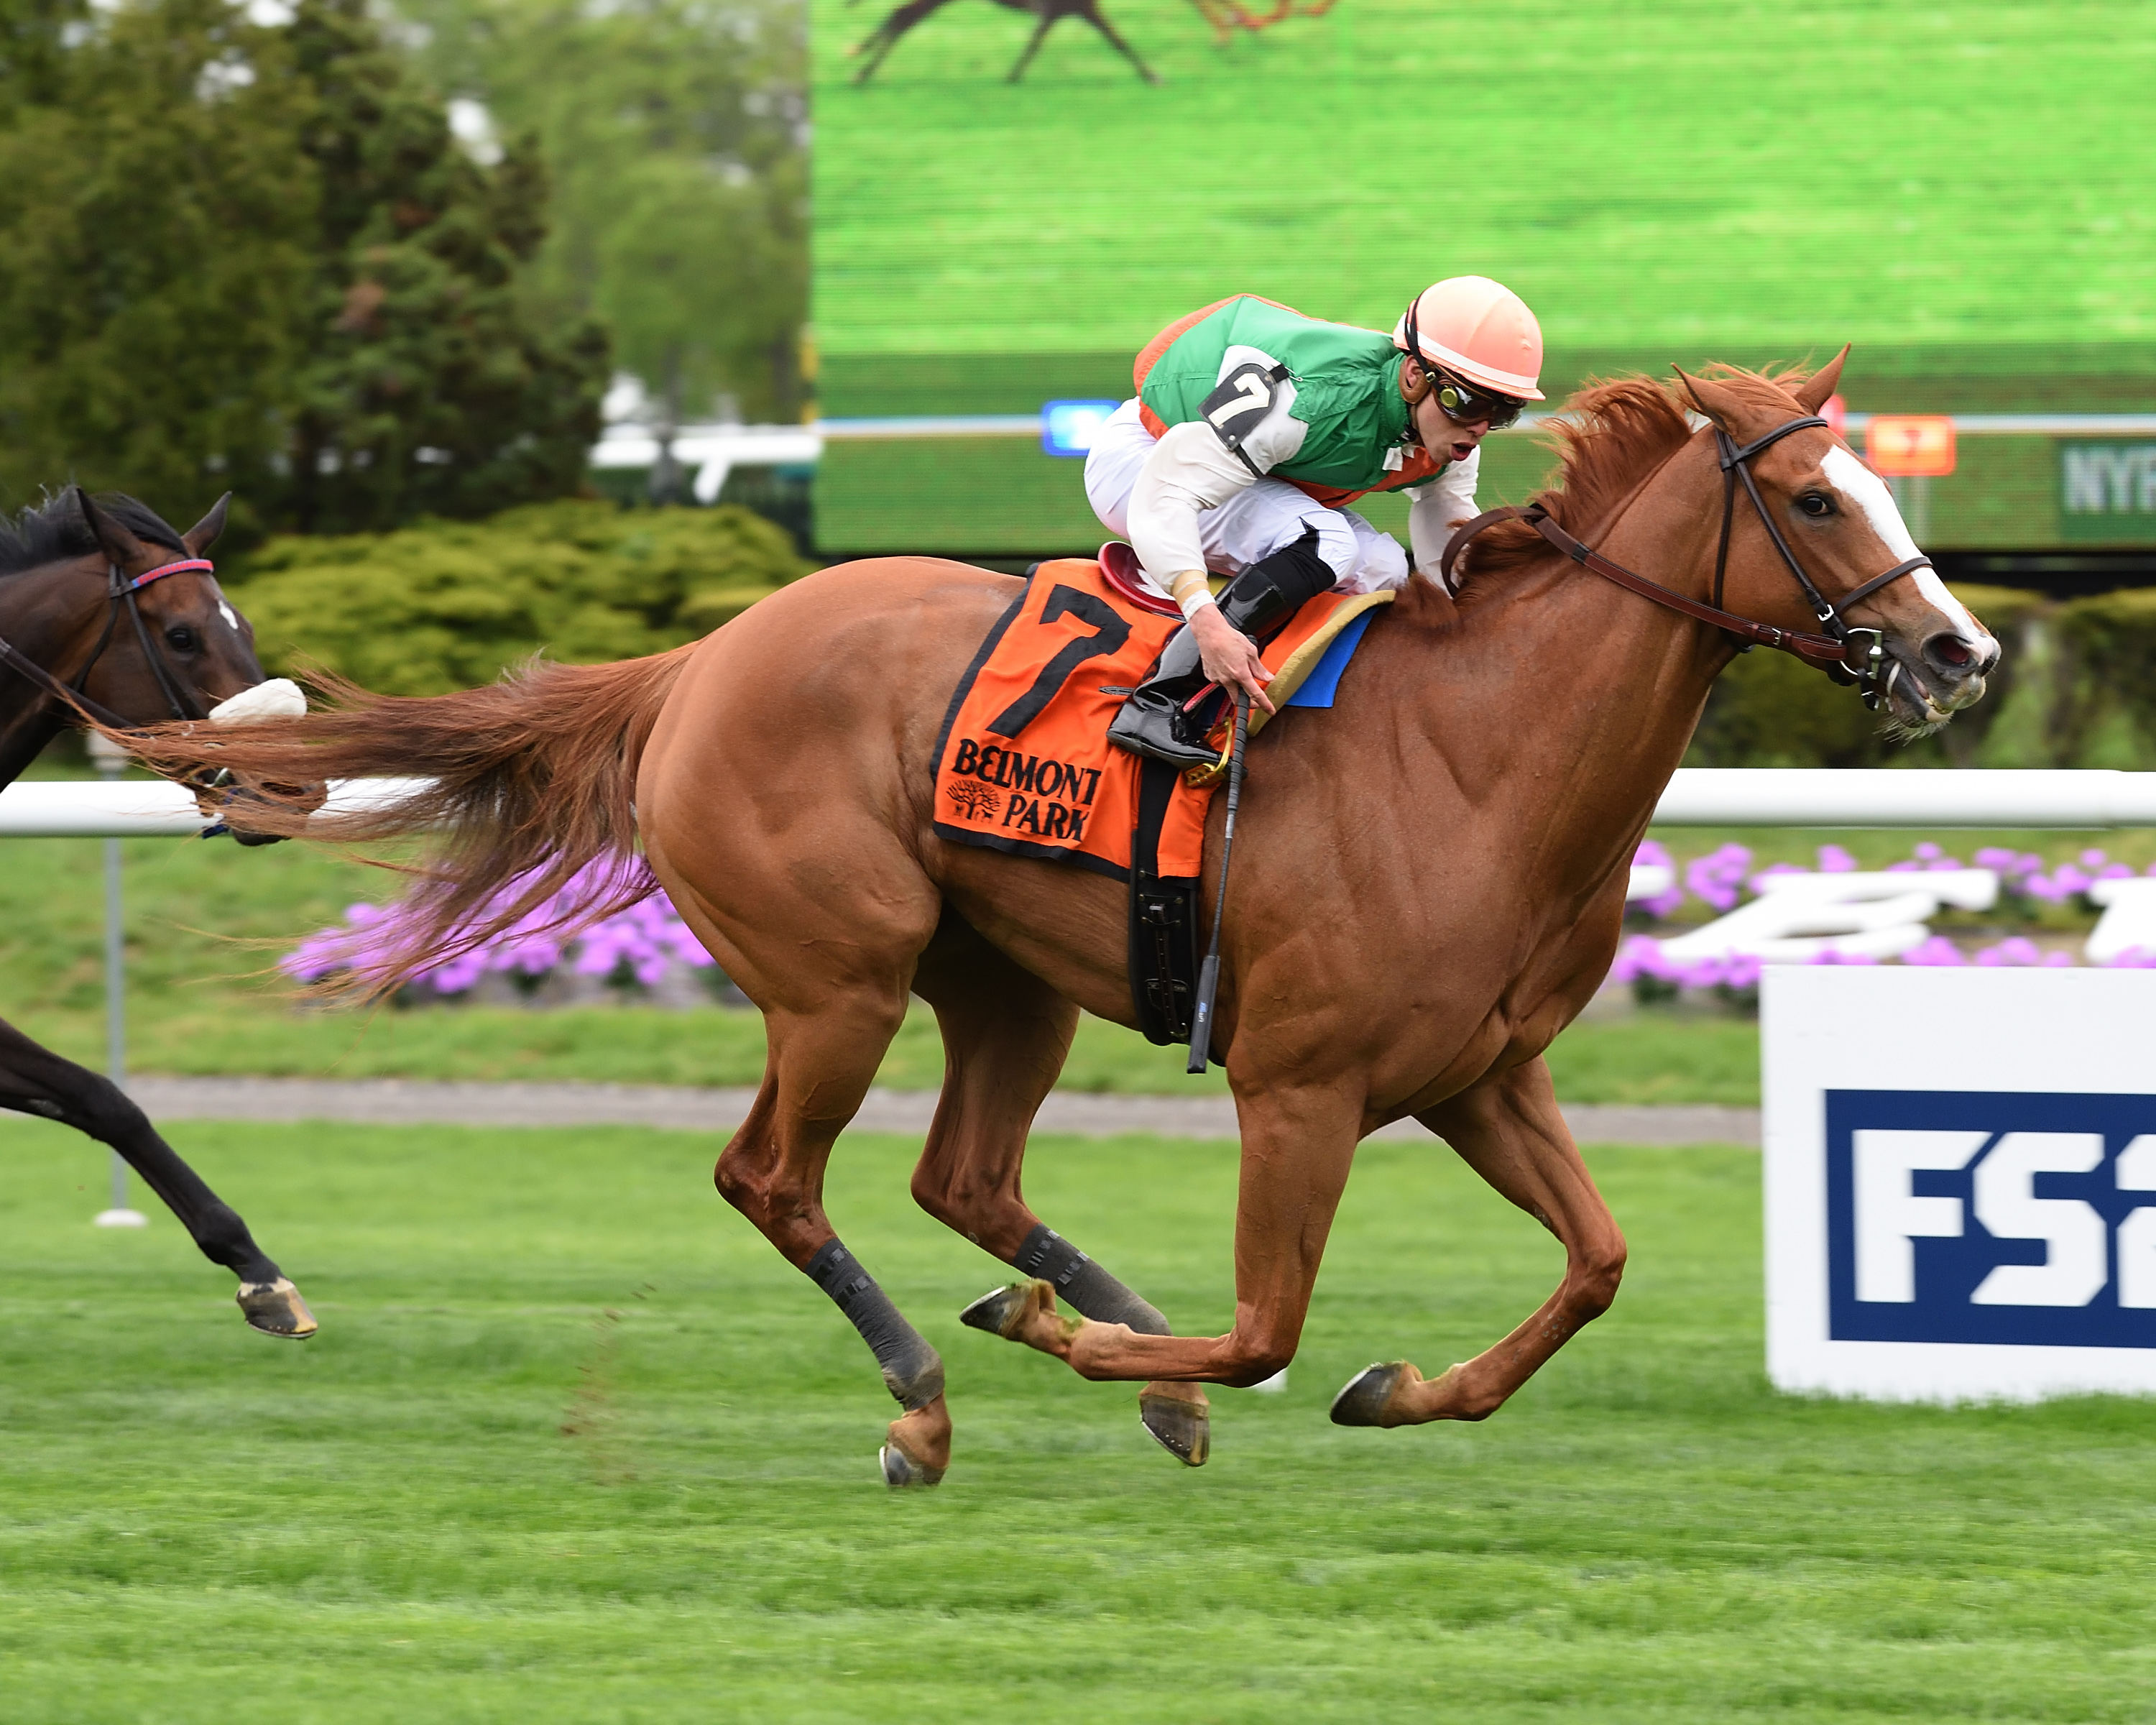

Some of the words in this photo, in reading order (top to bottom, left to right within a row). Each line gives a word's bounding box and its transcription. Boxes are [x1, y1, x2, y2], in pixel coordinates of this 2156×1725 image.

[1208, 373, 1271, 429] 7
[985, 584, 1133, 739] 7
[952, 739, 1102, 805] BELMONT
[1002, 794, 1089, 842] PARK
